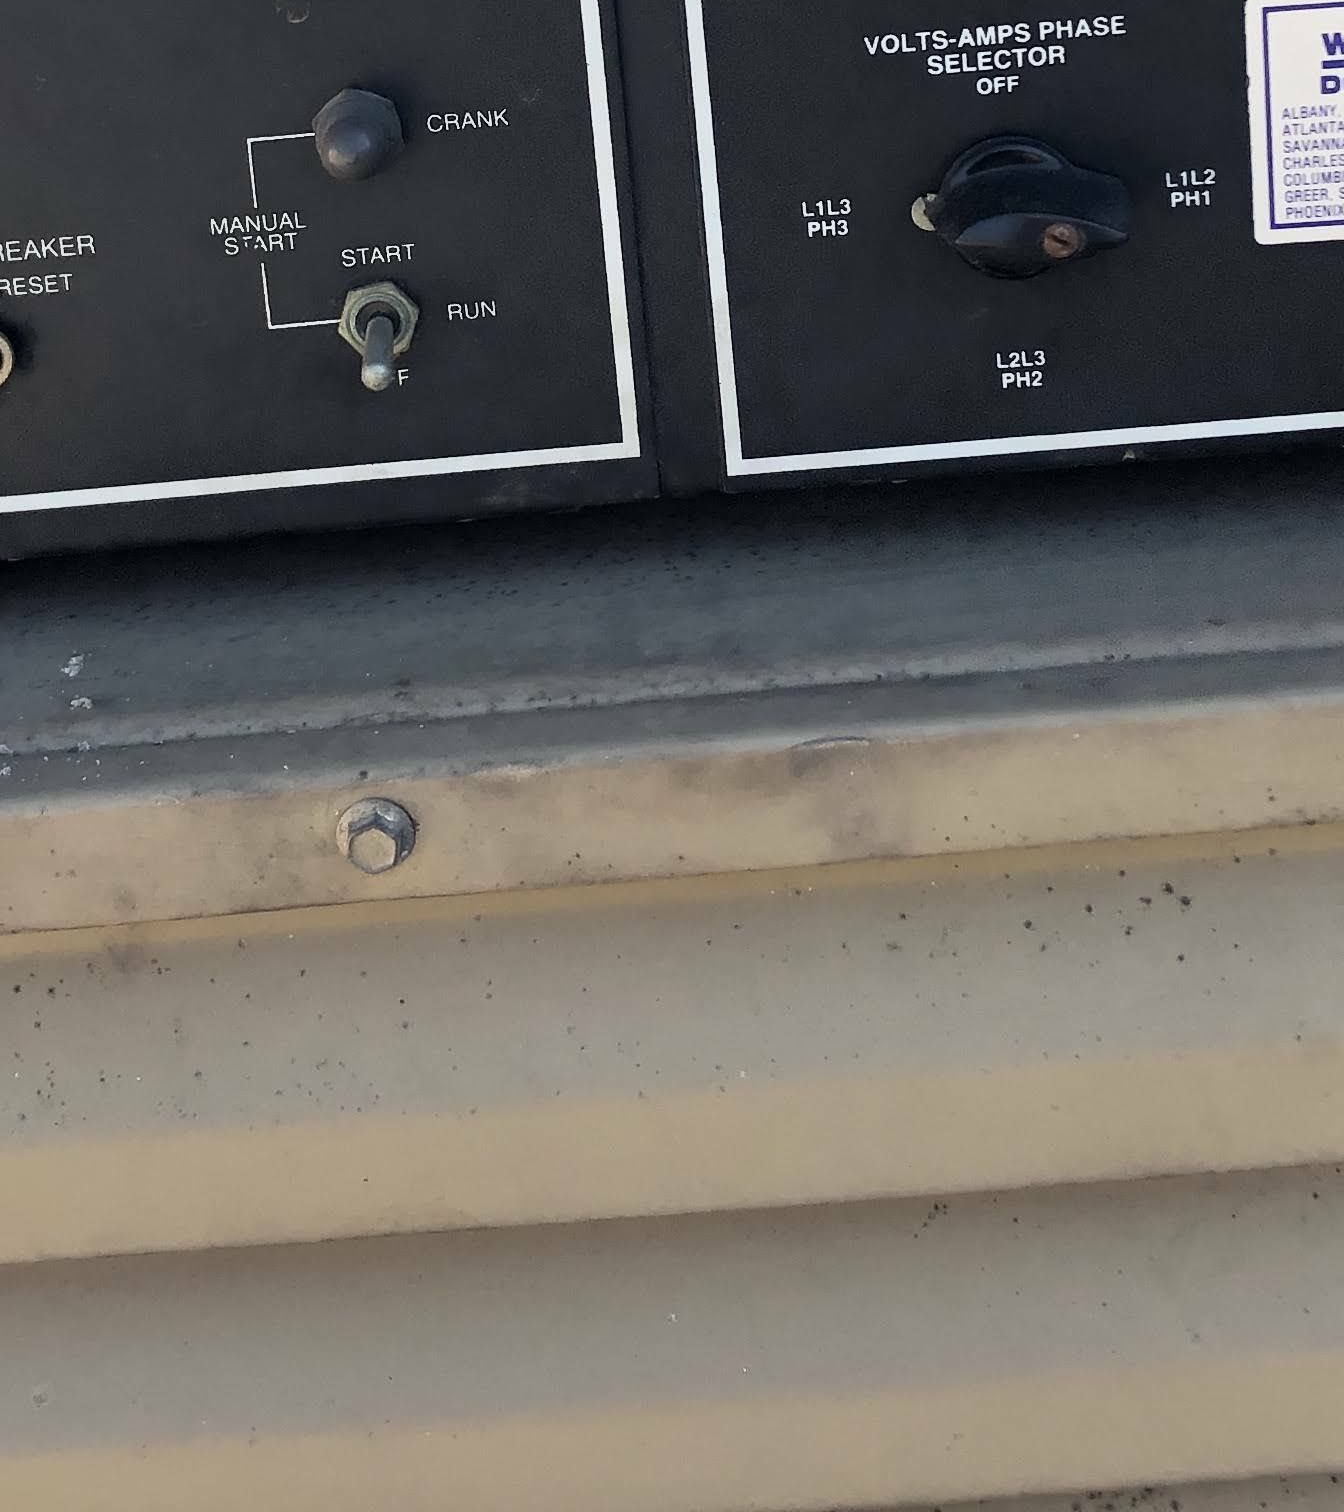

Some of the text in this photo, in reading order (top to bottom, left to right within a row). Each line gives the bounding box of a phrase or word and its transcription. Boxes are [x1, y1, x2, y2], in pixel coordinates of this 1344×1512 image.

[864, 16, 1126, 55] VOLTS-AMPS PHASE
[927, 46, 1066, 75] SELECTOR
[976, 76, 1019, 95] OFF
[427, 109, 508, 133] CRANK
[1165, 169, 1216, 187] L1L2
[802, 199, 851, 217] L1L3
[1170, 190, 1212, 207] PH1
[210, 212, 306, 235] MANUAL
[808, 220, 849, 238] PH3
[225, 233, 297, 255] START
[341, 244, 415, 267] START
[447, 301, 496, 320] RUN
[996, 351, 1046, 369] L2L3
[1002, 370, 1043, 389] PH2
